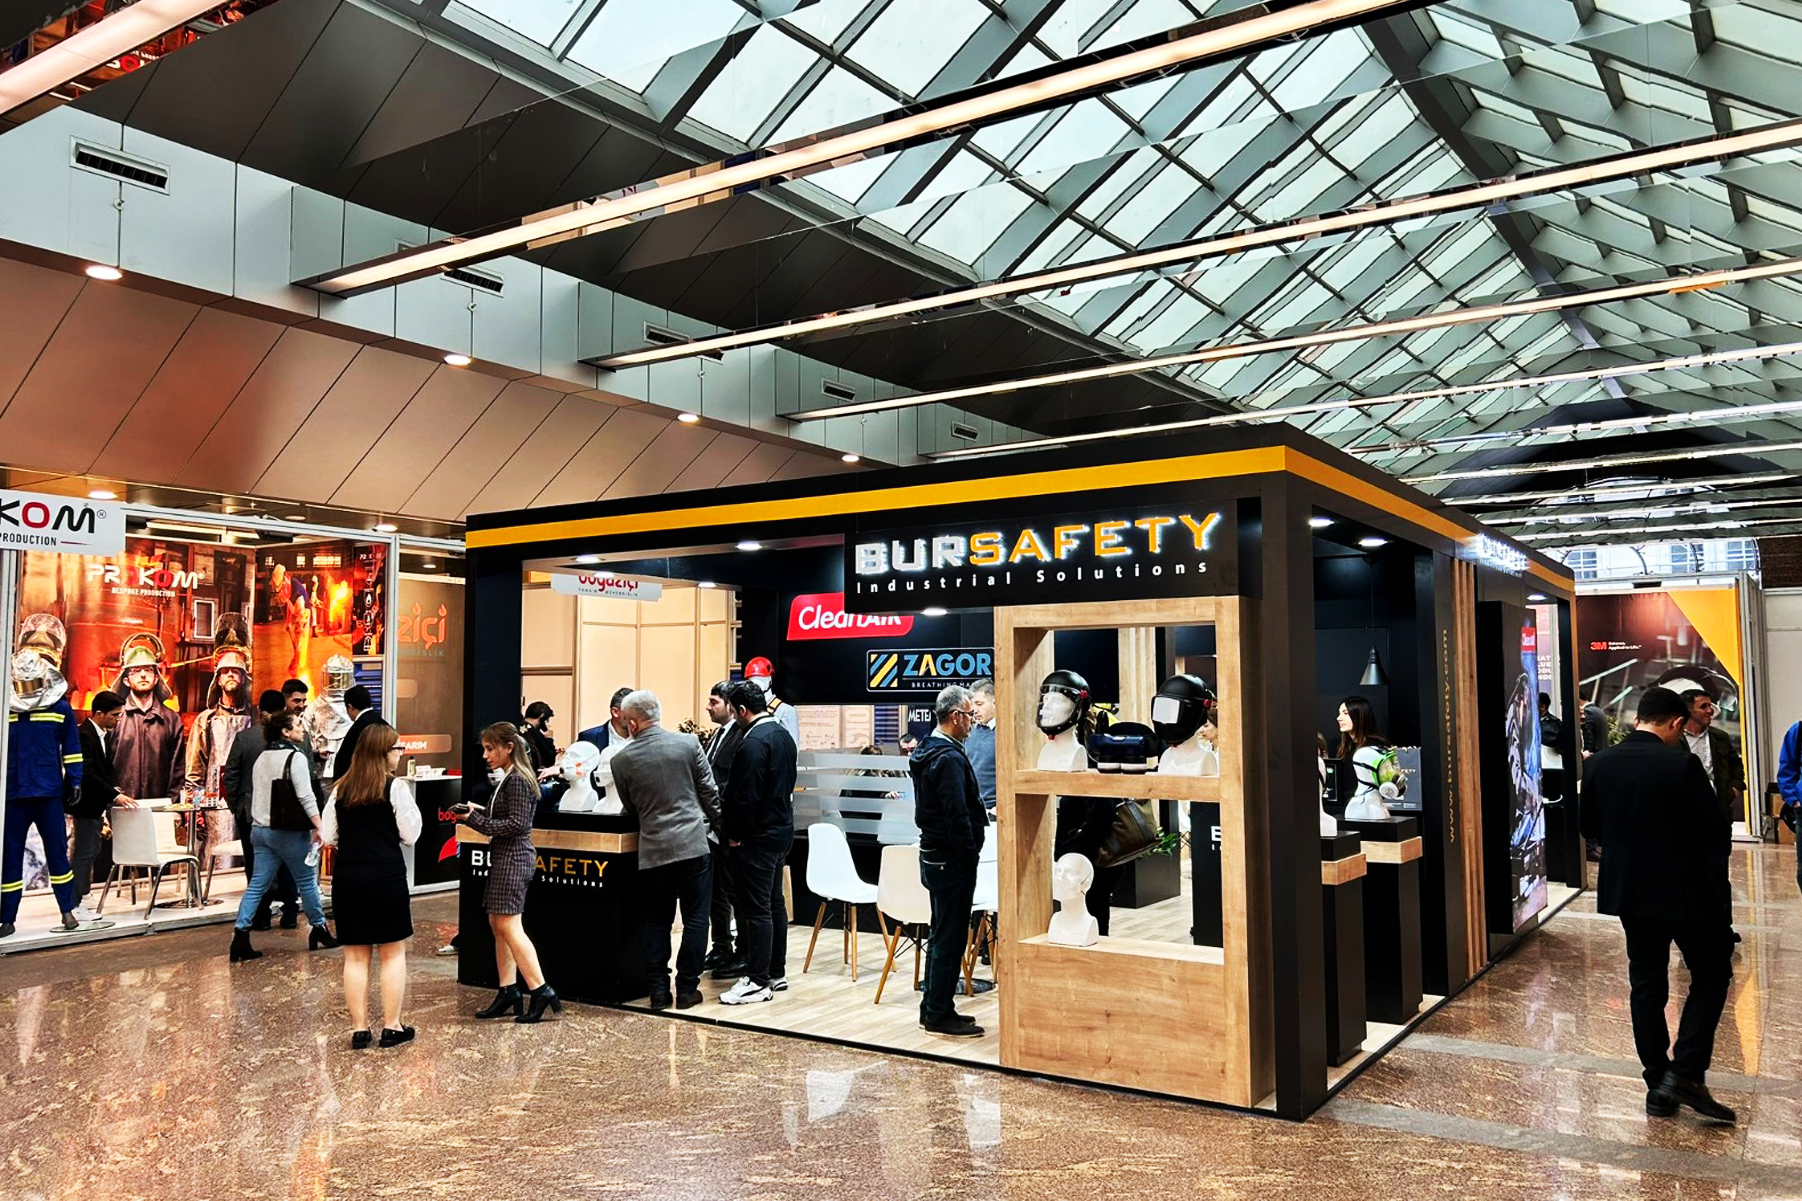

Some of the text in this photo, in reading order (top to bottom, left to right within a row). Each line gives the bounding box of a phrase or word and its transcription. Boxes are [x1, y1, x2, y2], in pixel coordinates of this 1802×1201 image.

[854, 512, 1221, 575] BURSAFETY
[857, 561, 1207, 594] Industrial Solutions
[140, 588, 176, 598] PRODUCTION
[1590, 641, 1607, 650] 3M
[903, 653, 992, 676] ZAGOR
[541, 875, 603, 888] Solutions
